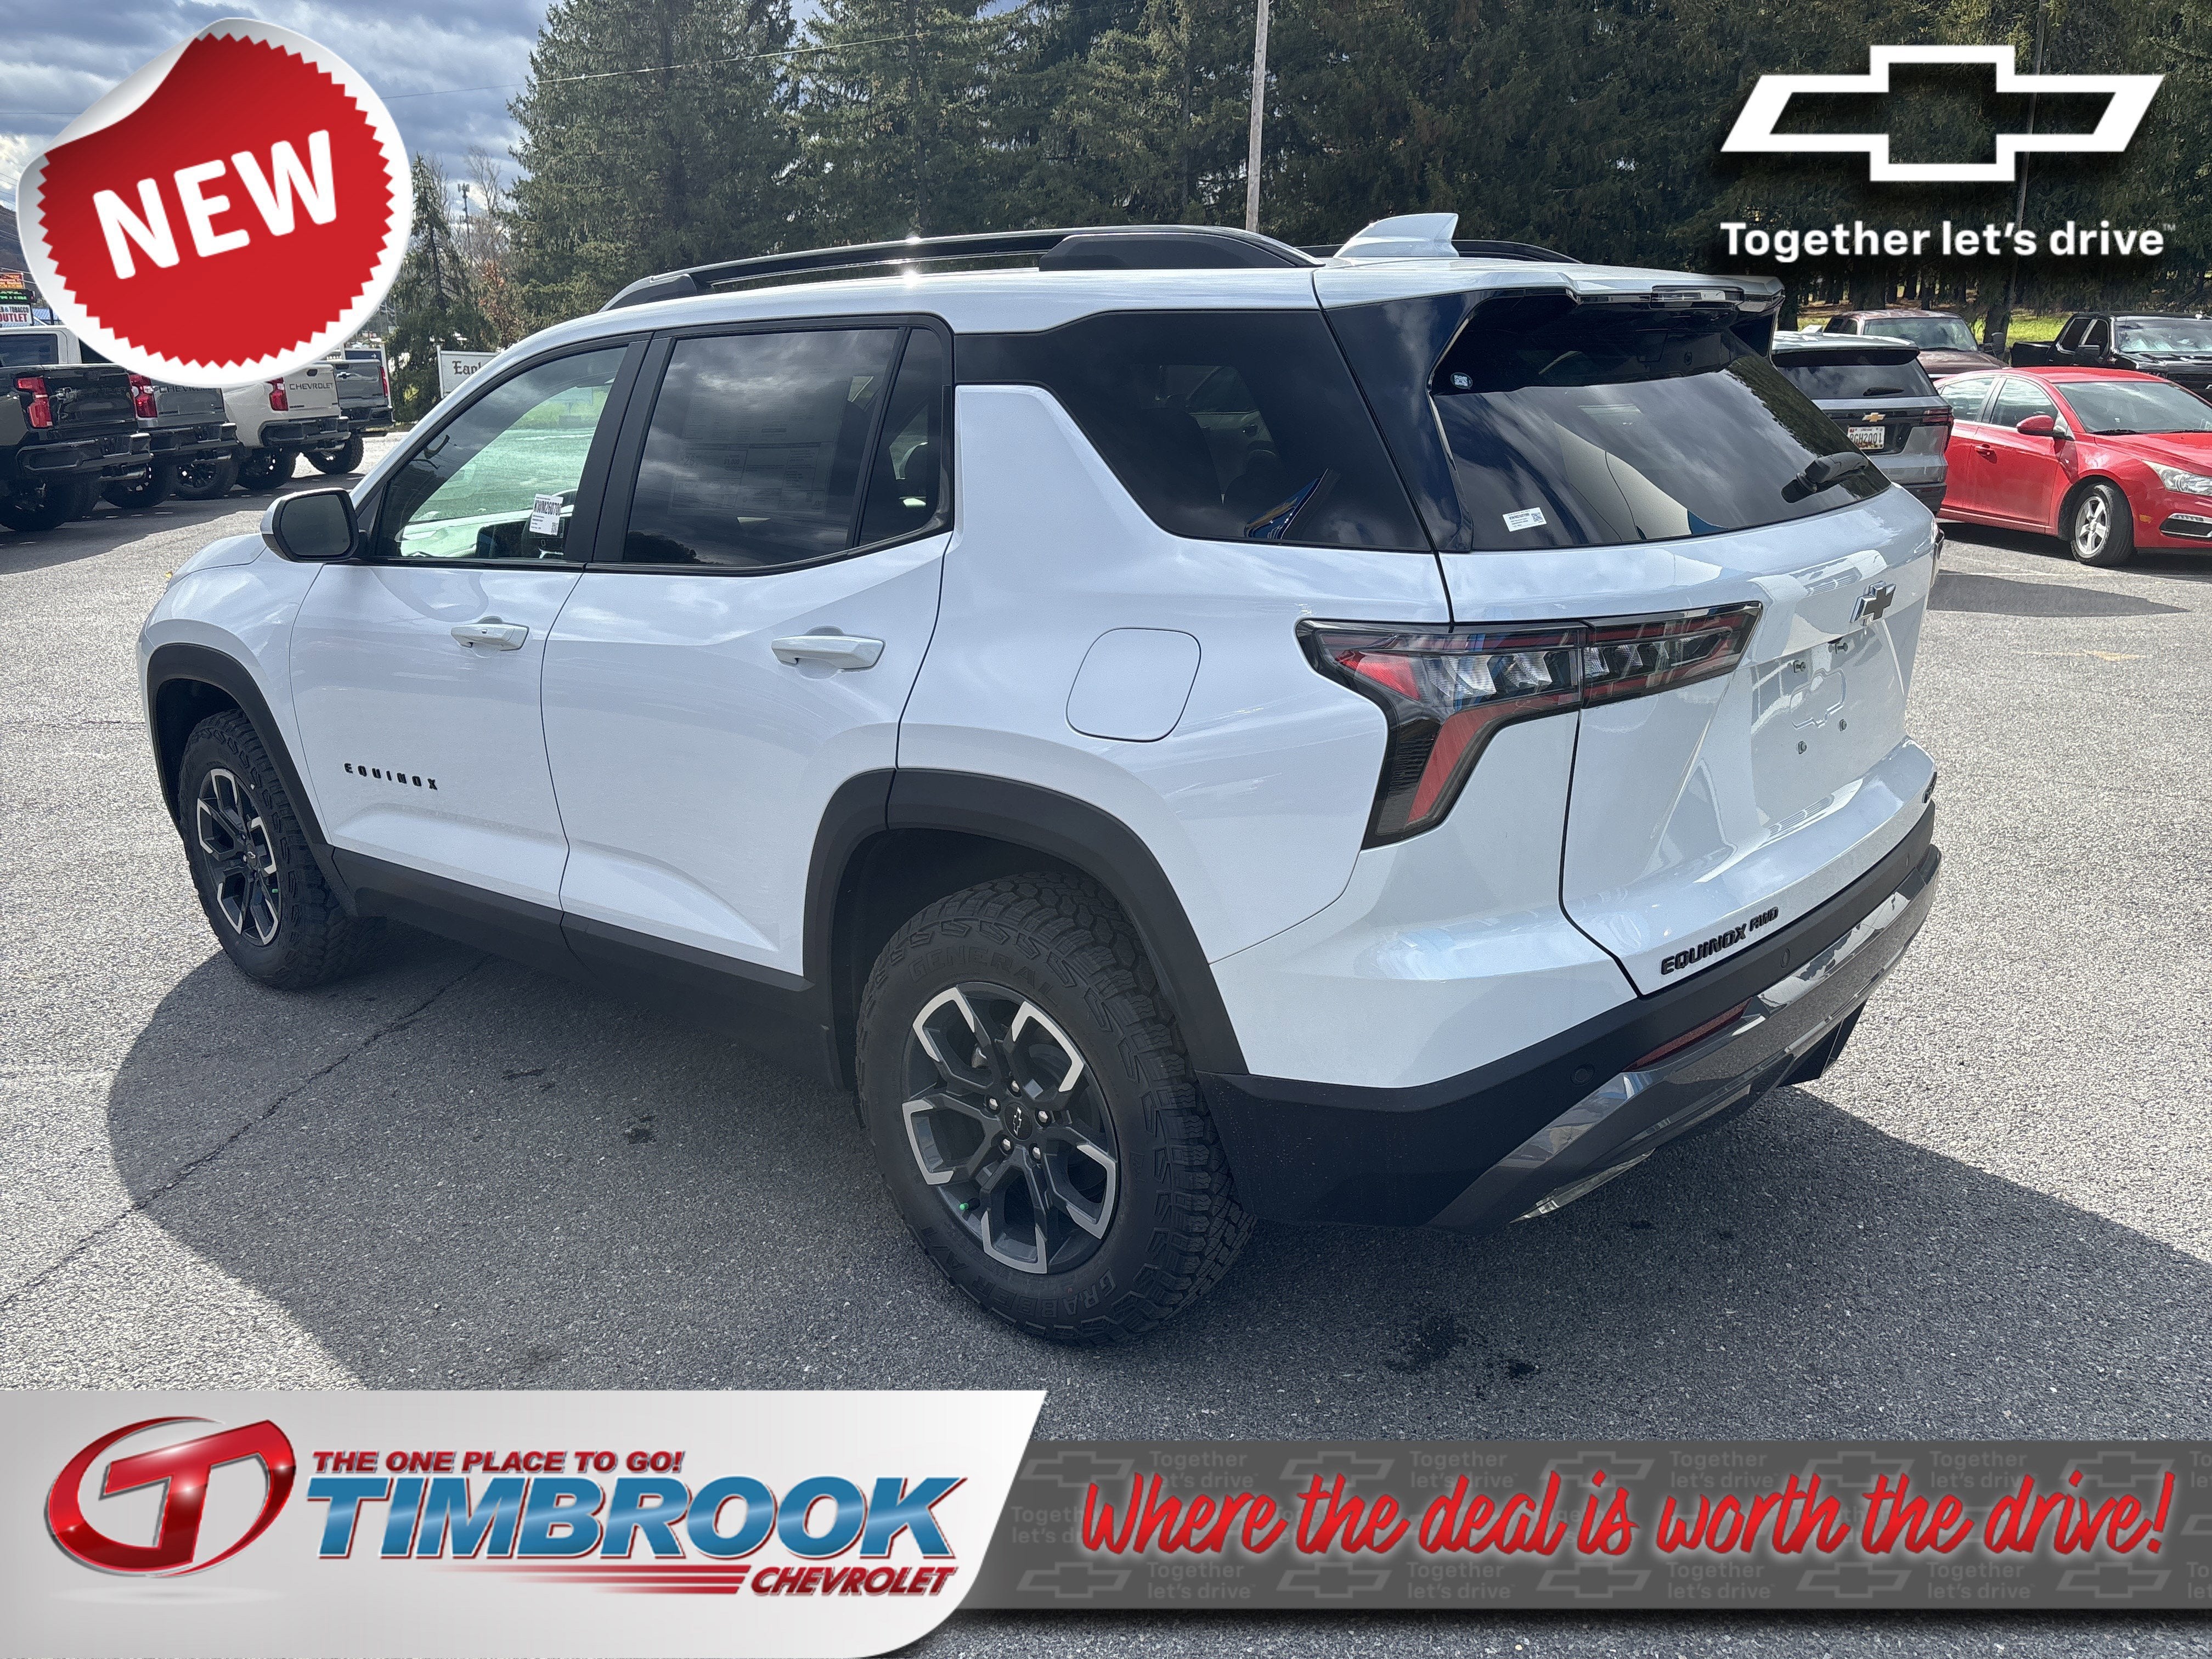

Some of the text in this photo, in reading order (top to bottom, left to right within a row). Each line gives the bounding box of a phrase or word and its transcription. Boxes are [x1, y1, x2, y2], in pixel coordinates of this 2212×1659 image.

[344, 762, 438, 791] EQUINOX
[1661, 906, 1779, 975] EQUINOX AWD
[907, 944, 1058, 1007] GENERAL
[972, 1267, 1118, 1318] GRABBER
